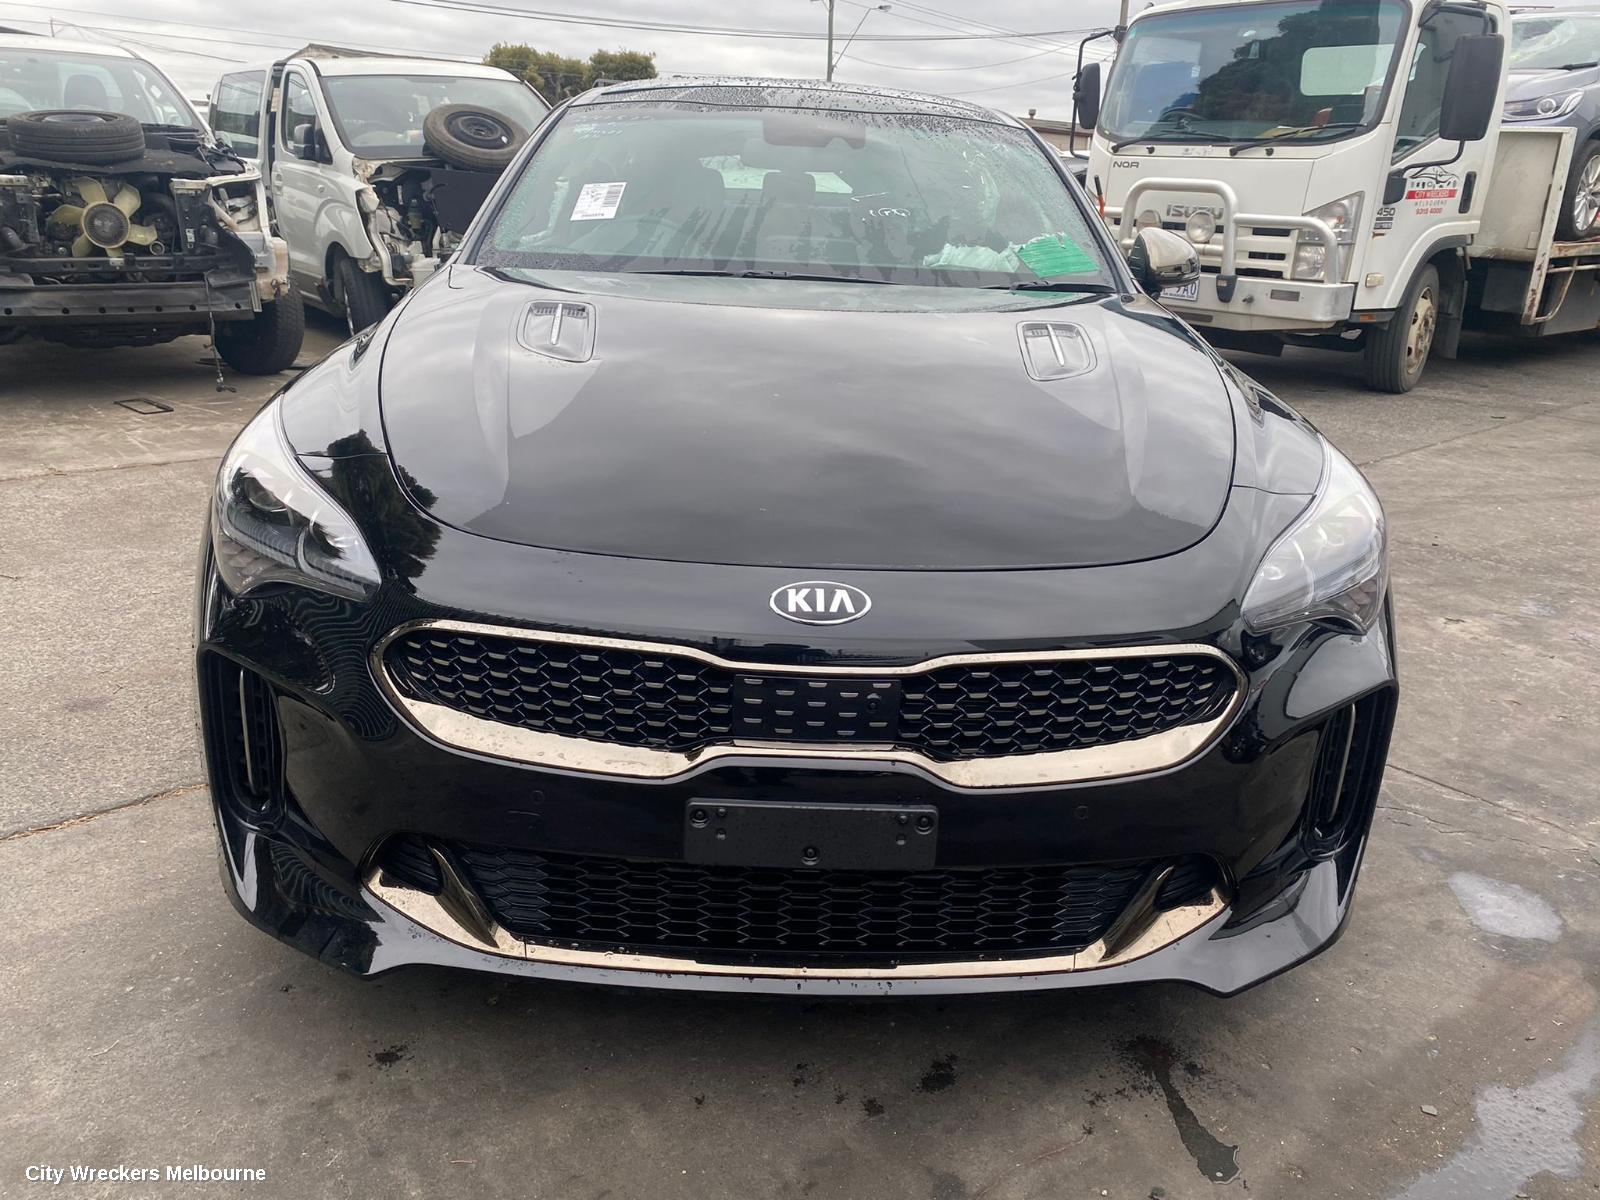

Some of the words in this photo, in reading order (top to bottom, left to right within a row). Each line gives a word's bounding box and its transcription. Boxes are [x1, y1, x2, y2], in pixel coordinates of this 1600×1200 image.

[1415, 190, 1425, 199] CITY
[1376, 207, 1396, 216] 450
[786, 588, 856, 613] KIA
